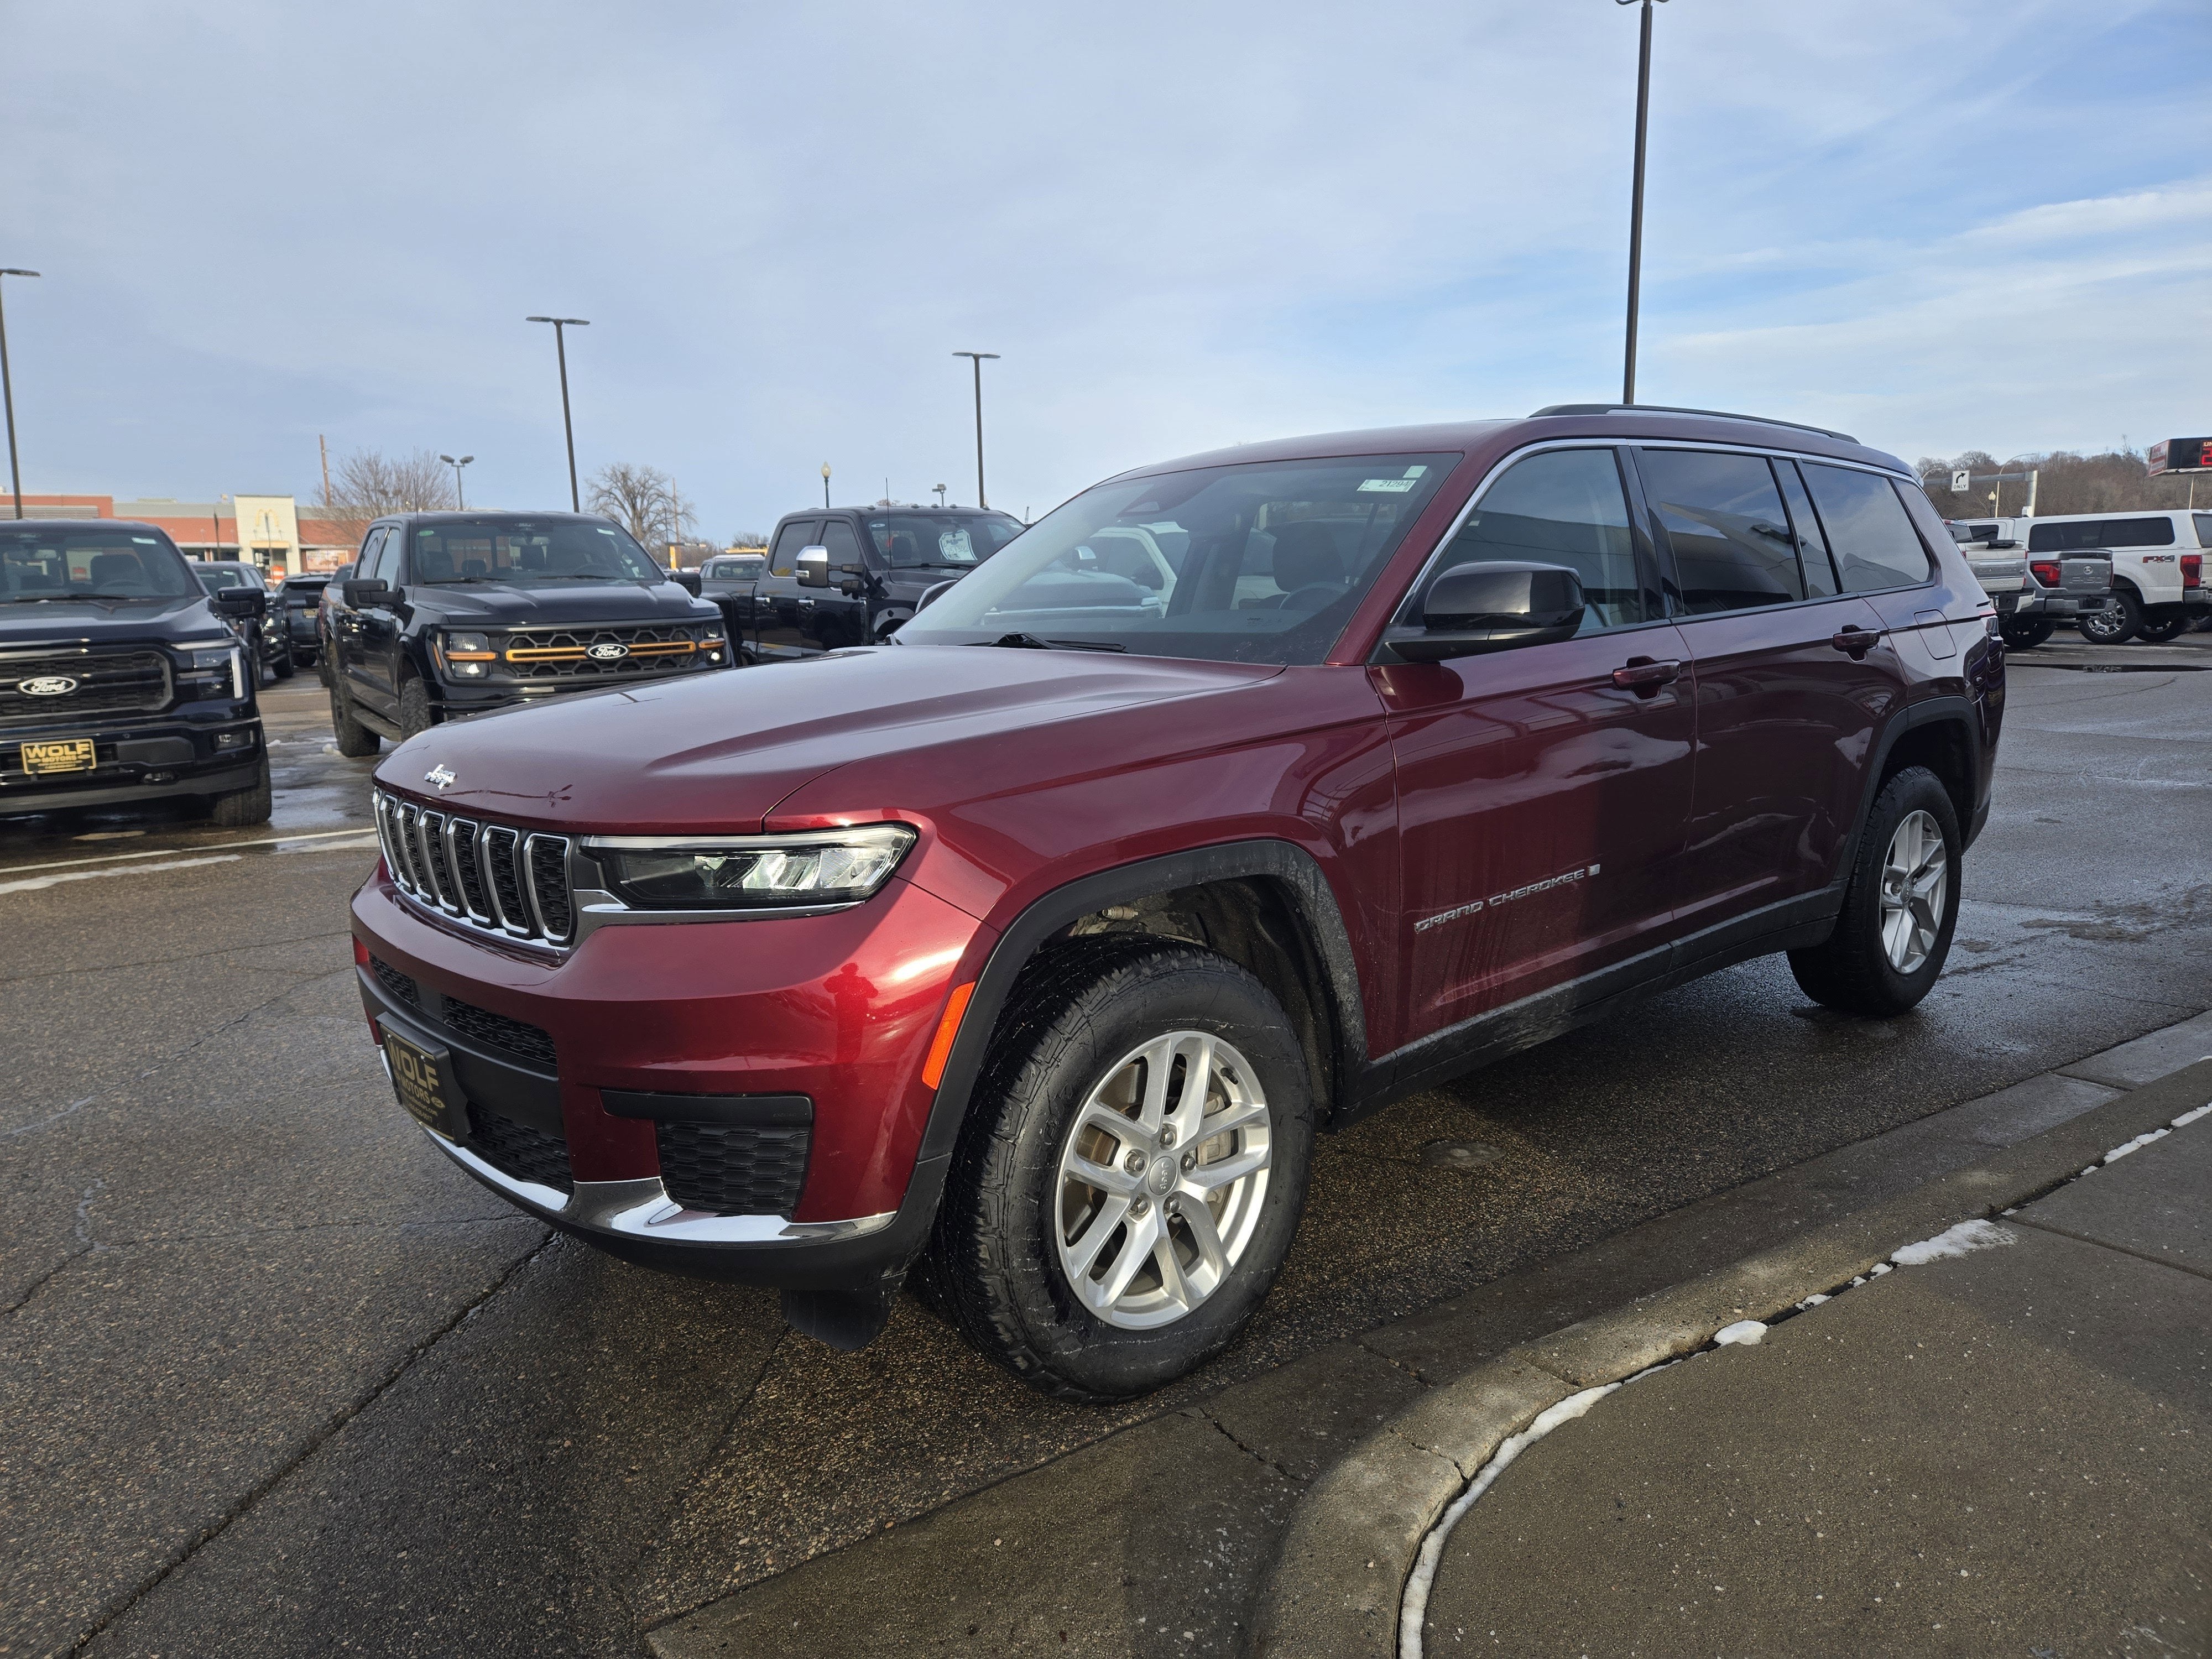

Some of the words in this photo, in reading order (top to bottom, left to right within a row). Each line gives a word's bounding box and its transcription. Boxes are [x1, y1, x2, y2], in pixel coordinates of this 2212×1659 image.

[2143, 555, 2175, 564] FX4
[596, 646, 620, 656] Ford
[31, 679, 66, 692] Ford
[25, 743, 90, 758] WOLF
[424, 764, 456, 790] Jeep
[1415, 901, 1484, 933] GRAND
[1488, 869, 1585, 907] CHEROKEE
[386, 1041, 439, 1092] WOLF
[401, 1077, 430, 1104] MOTORS
[1159, 1161, 1170, 1190] Jeep
